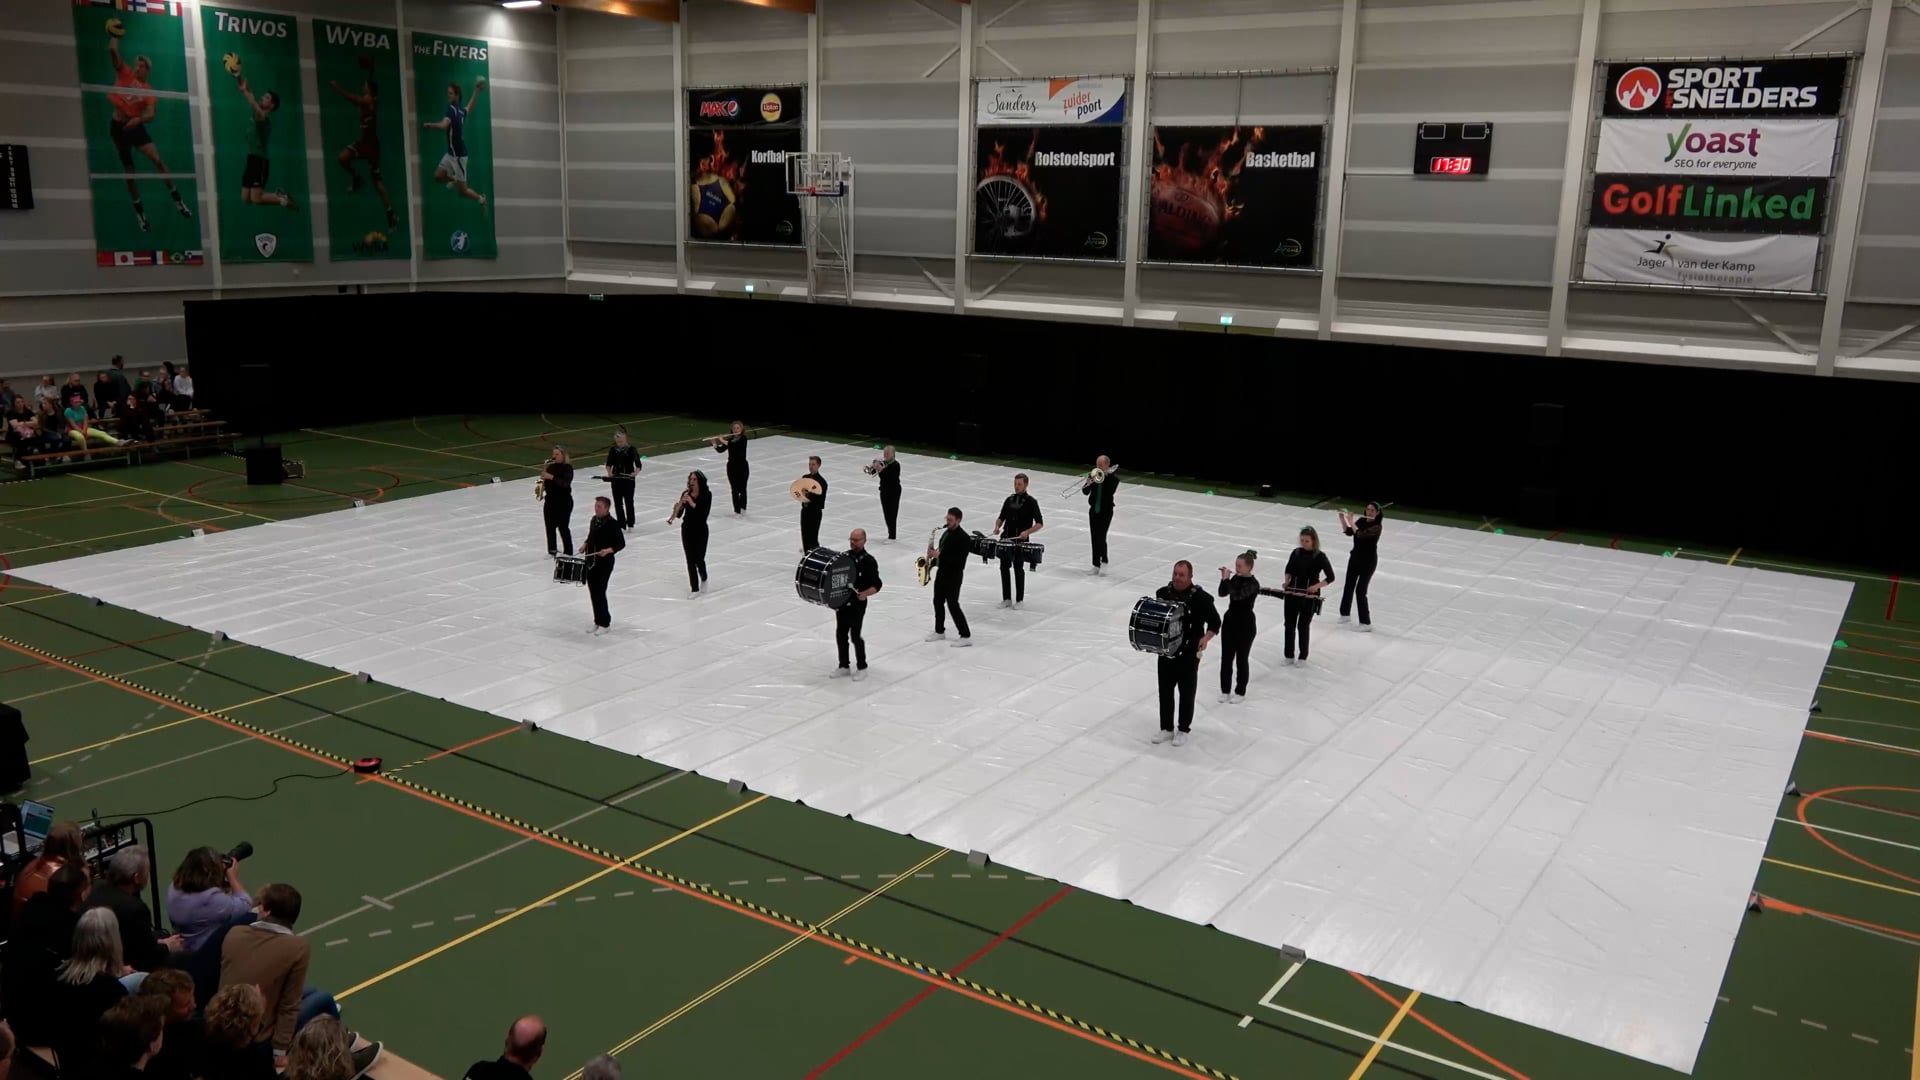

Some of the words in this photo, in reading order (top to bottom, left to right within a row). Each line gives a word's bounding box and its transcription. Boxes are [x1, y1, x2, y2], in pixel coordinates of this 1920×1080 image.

[214, 11, 288, 38] TRIVOS
[326, 25, 391, 50] WYBA
[414, 44, 431, 56] THE
[432, 39, 488, 61] FLYERS
[1668, 67, 1762, 89] SPORT
[987, 93, 1037, 115] Sanders
[1063, 91, 1092, 110] zuider
[1672, 86, 1818, 109] SNELDERS
[700, 100, 727, 117] MAX
[1077, 98, 1102, 120] poort
[751, 150, 785, 163] Korfbal
[1034, 151, 1115, 168] Rolstoelsport
[1245, 151, 1316, 168] Basketbal
[1436, 158, 1471, 171] 17:30
[1674, 158, 1694, 168] SEO
[1696, 158, 1711, 168] for
[1712, 160, 1757, 169] everyone
[1603, 184, 1815, 219] GolfLinked
[1636, 256, 1667, 268] Jager
[1677, 260, 1698, 269] van
[1700, 260, 1719, 269] der
[1721, 261, 1756, 272] Kamp
